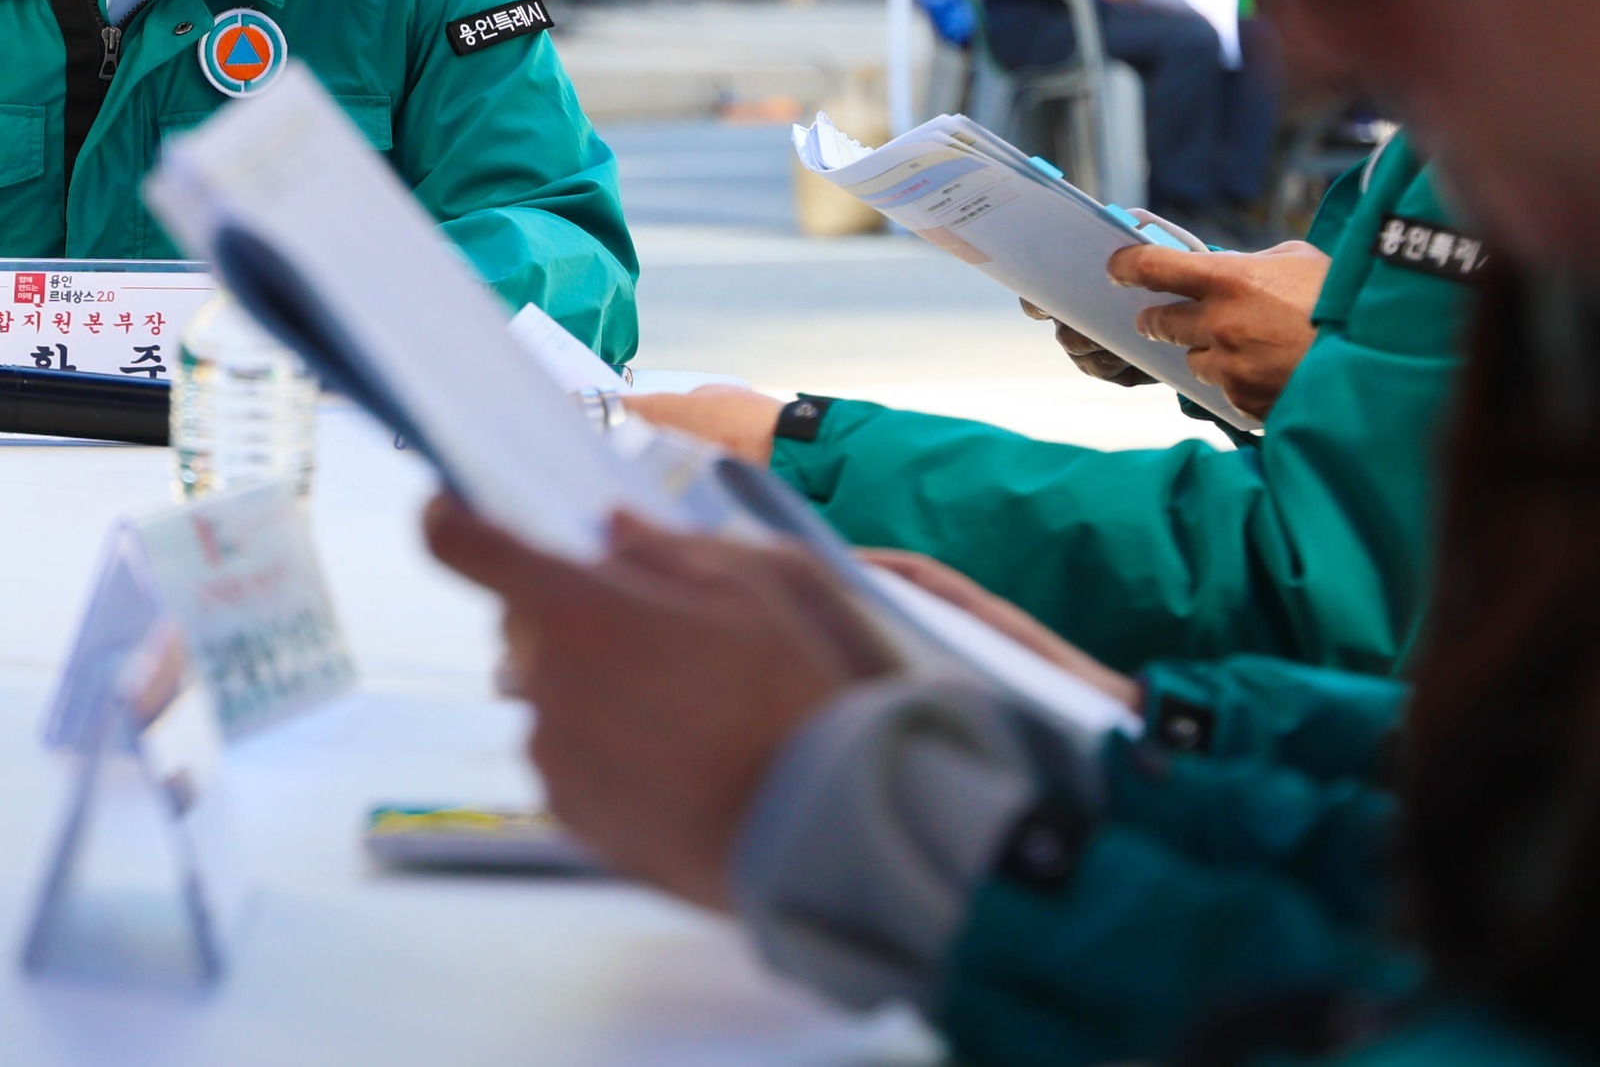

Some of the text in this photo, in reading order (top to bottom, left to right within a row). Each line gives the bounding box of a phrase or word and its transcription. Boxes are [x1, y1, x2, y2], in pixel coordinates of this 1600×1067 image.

[459, 1, 547, 46] 용인특례시
[49, 275, 73, 289] 용인
[49, 290, 115, 304] 르네상스 2.0
